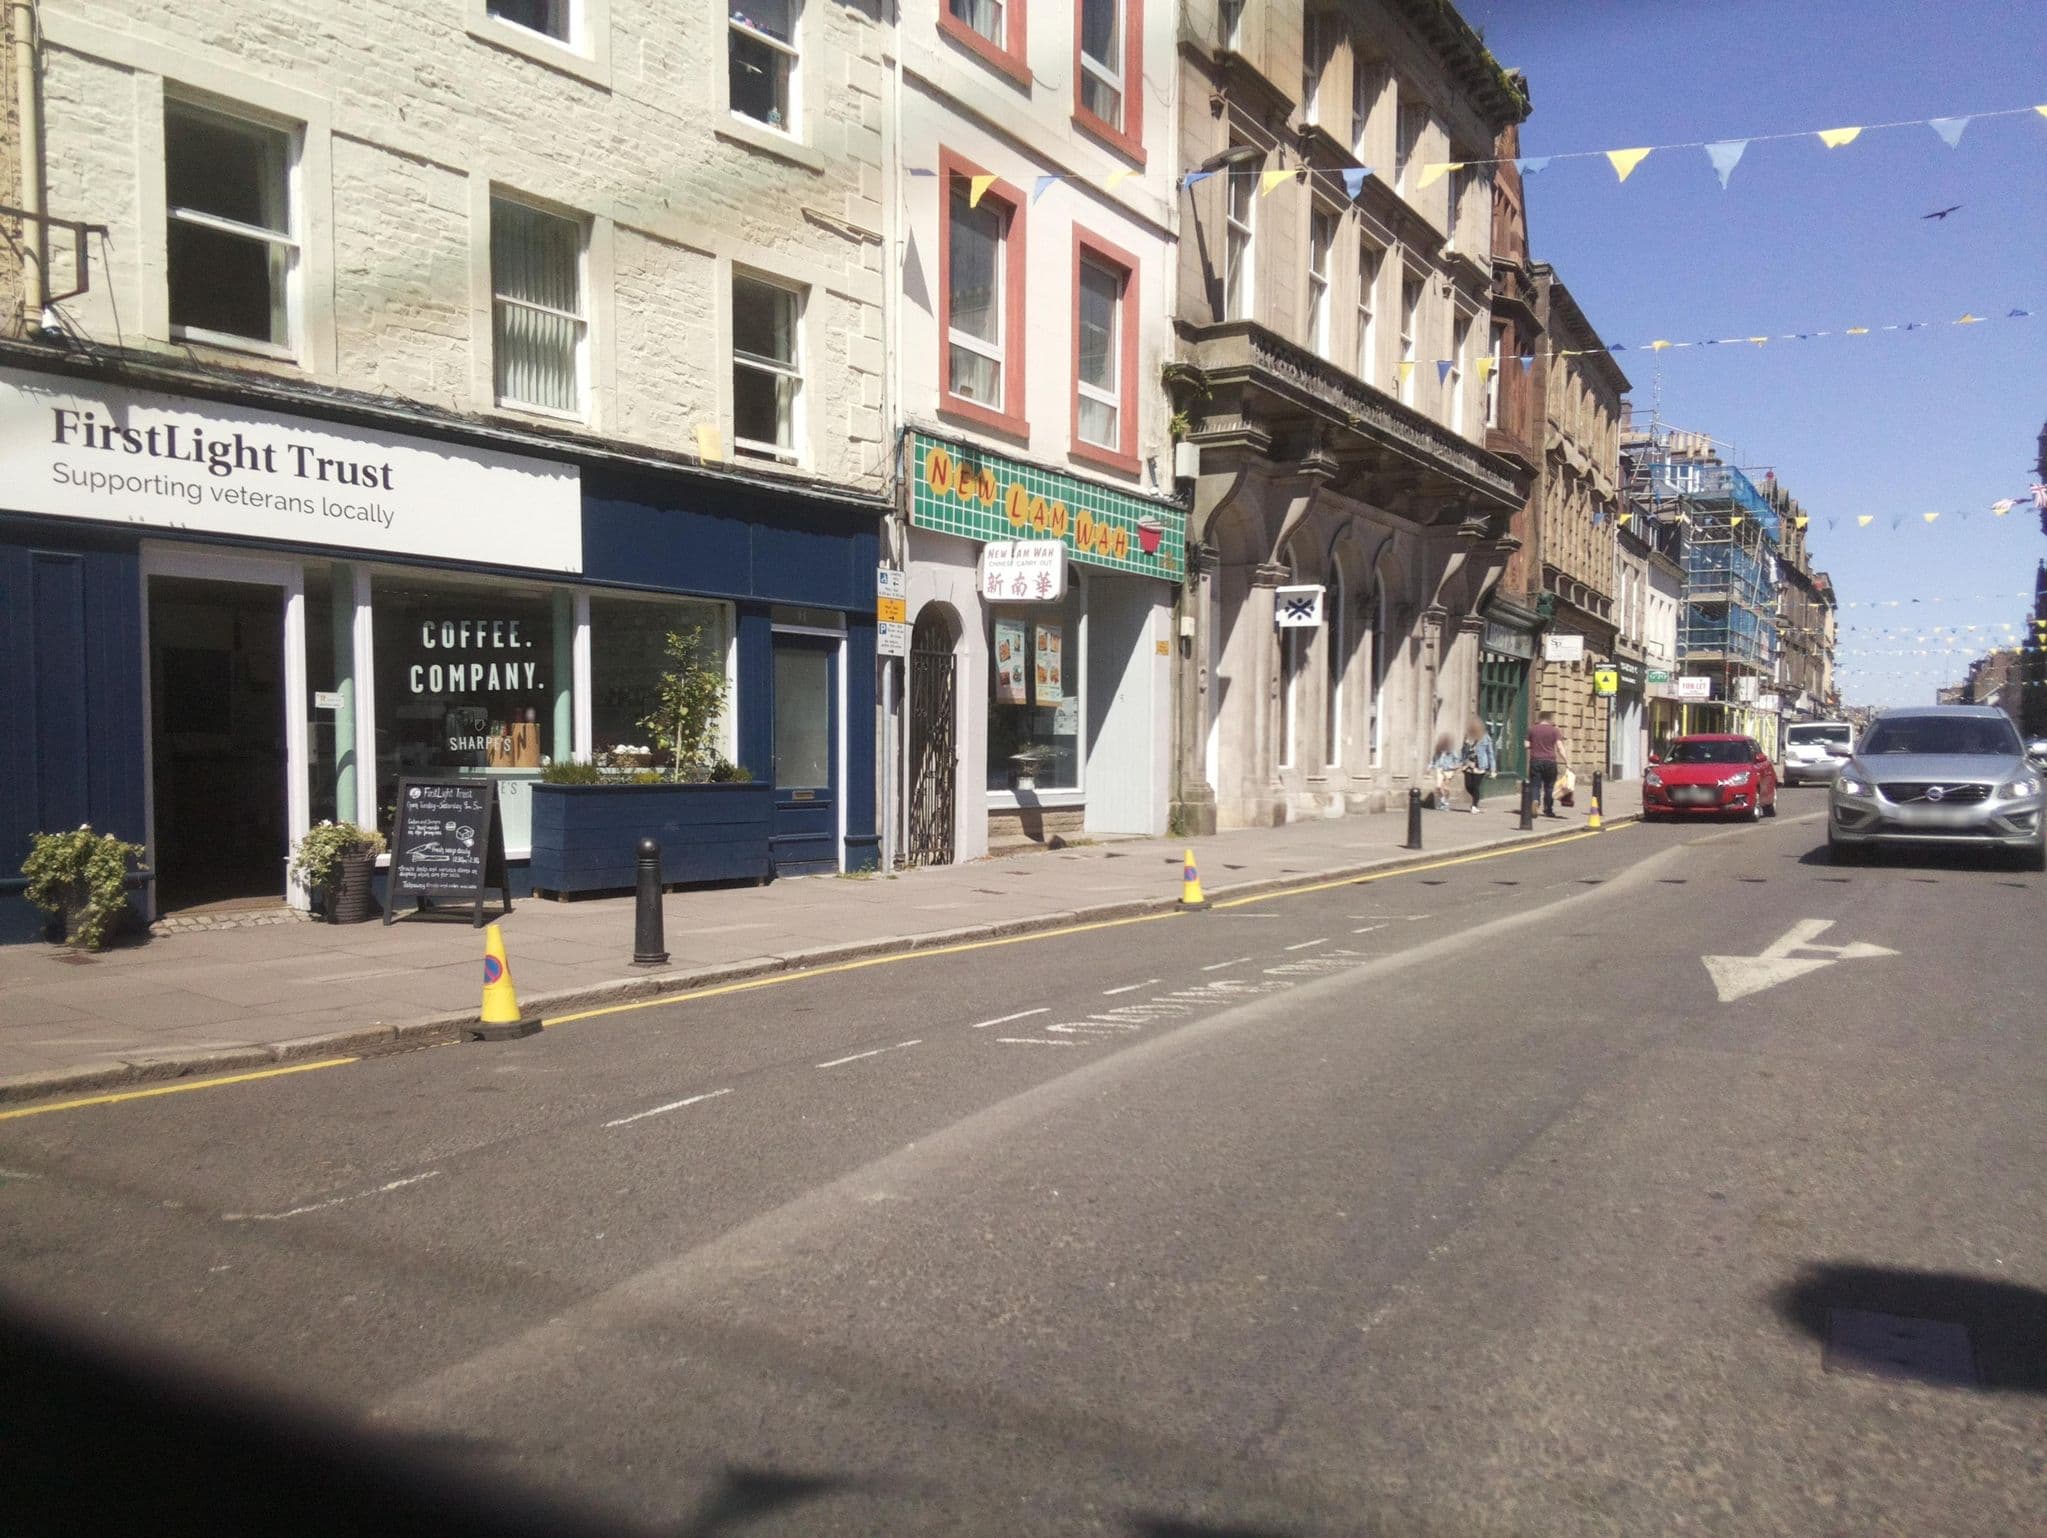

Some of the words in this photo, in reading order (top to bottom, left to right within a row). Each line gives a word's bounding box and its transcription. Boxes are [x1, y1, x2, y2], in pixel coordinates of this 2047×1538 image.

[51, 406, 277, 477] FirstLight
[288, 444, 395, 491] Trust
[52, 461, 202, 504] Supporting
[210, 484, 315, 515] veterans
[322, 496, 395, 529] locally
[931, 455, 994, 500] NEW
[1011, 489, 1065, 532] LAM
[1076, 521, 1127, 555] WAH
[422, 620, 532, 648] COFFEE.
[410, 662, 544, 693] COMPANY.
[450, 736, 512, 752] SHARPE'S
